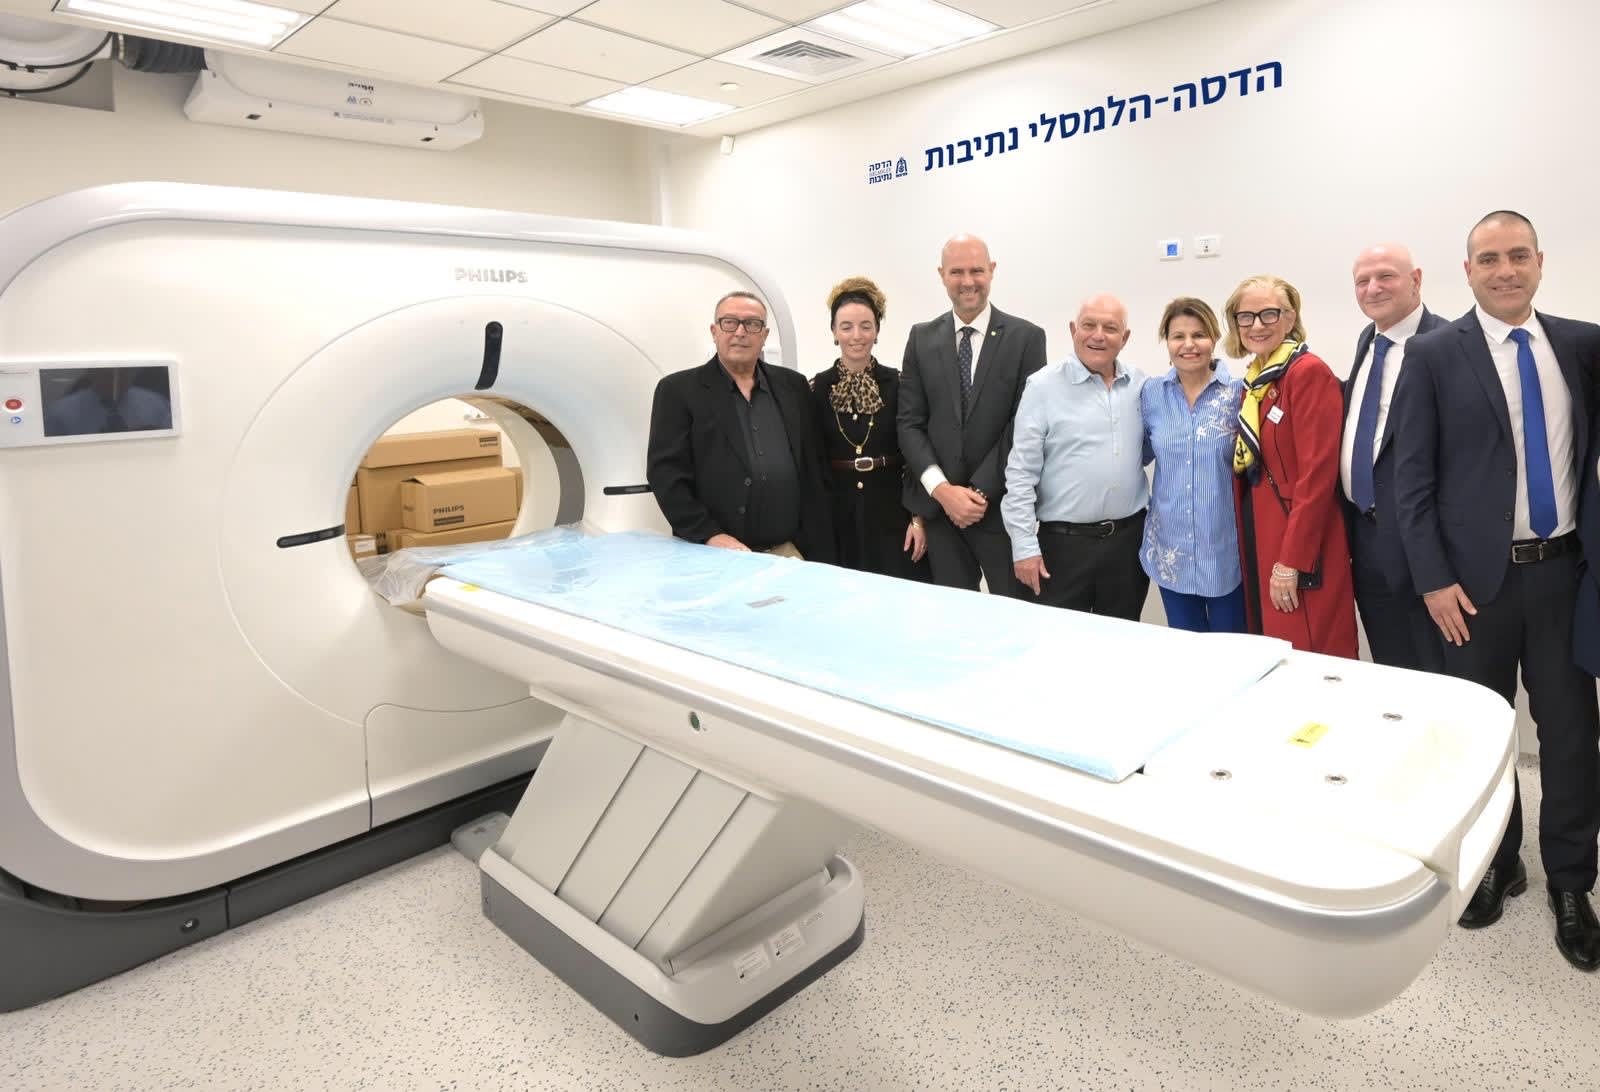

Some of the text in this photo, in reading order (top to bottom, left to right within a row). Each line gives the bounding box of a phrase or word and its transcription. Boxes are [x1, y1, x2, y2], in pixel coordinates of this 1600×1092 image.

[924, 126, 1019, 172] נתיבות
[868, 159, 892, 172] הדסה
[868, 172, 892, 185] נתיבות
[454, 266, 529, 284] PHILIPS
[433, 504, 465, 514] PHILIPS
